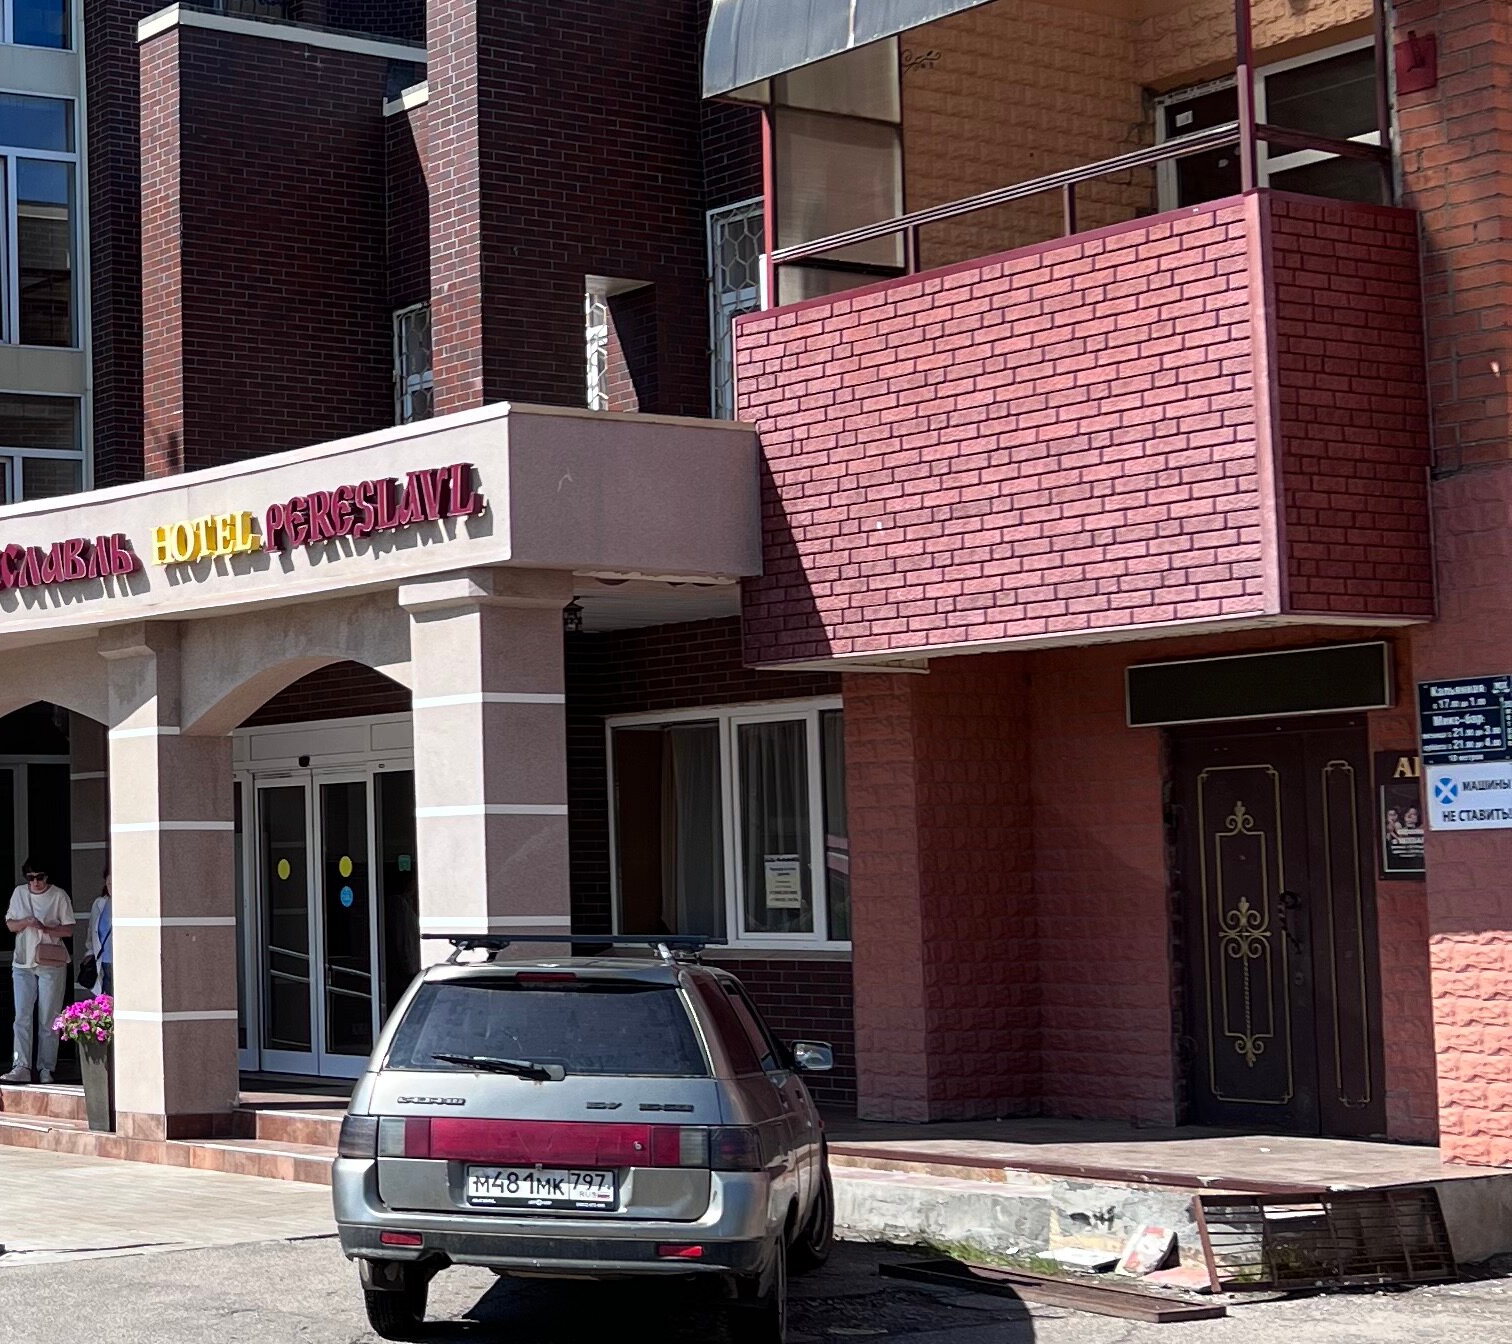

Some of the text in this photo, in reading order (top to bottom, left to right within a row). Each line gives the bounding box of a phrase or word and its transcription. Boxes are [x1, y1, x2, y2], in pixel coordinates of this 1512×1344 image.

[150, 510, 262, 566] HOTEL
[264, 462, 484, 554] PERESLAVL
[1462, 778, 1511, 791] МАШИНЫ
[1442, 810, 1456, 822] НЕ
[570, 1172, 606, 1191] 797
